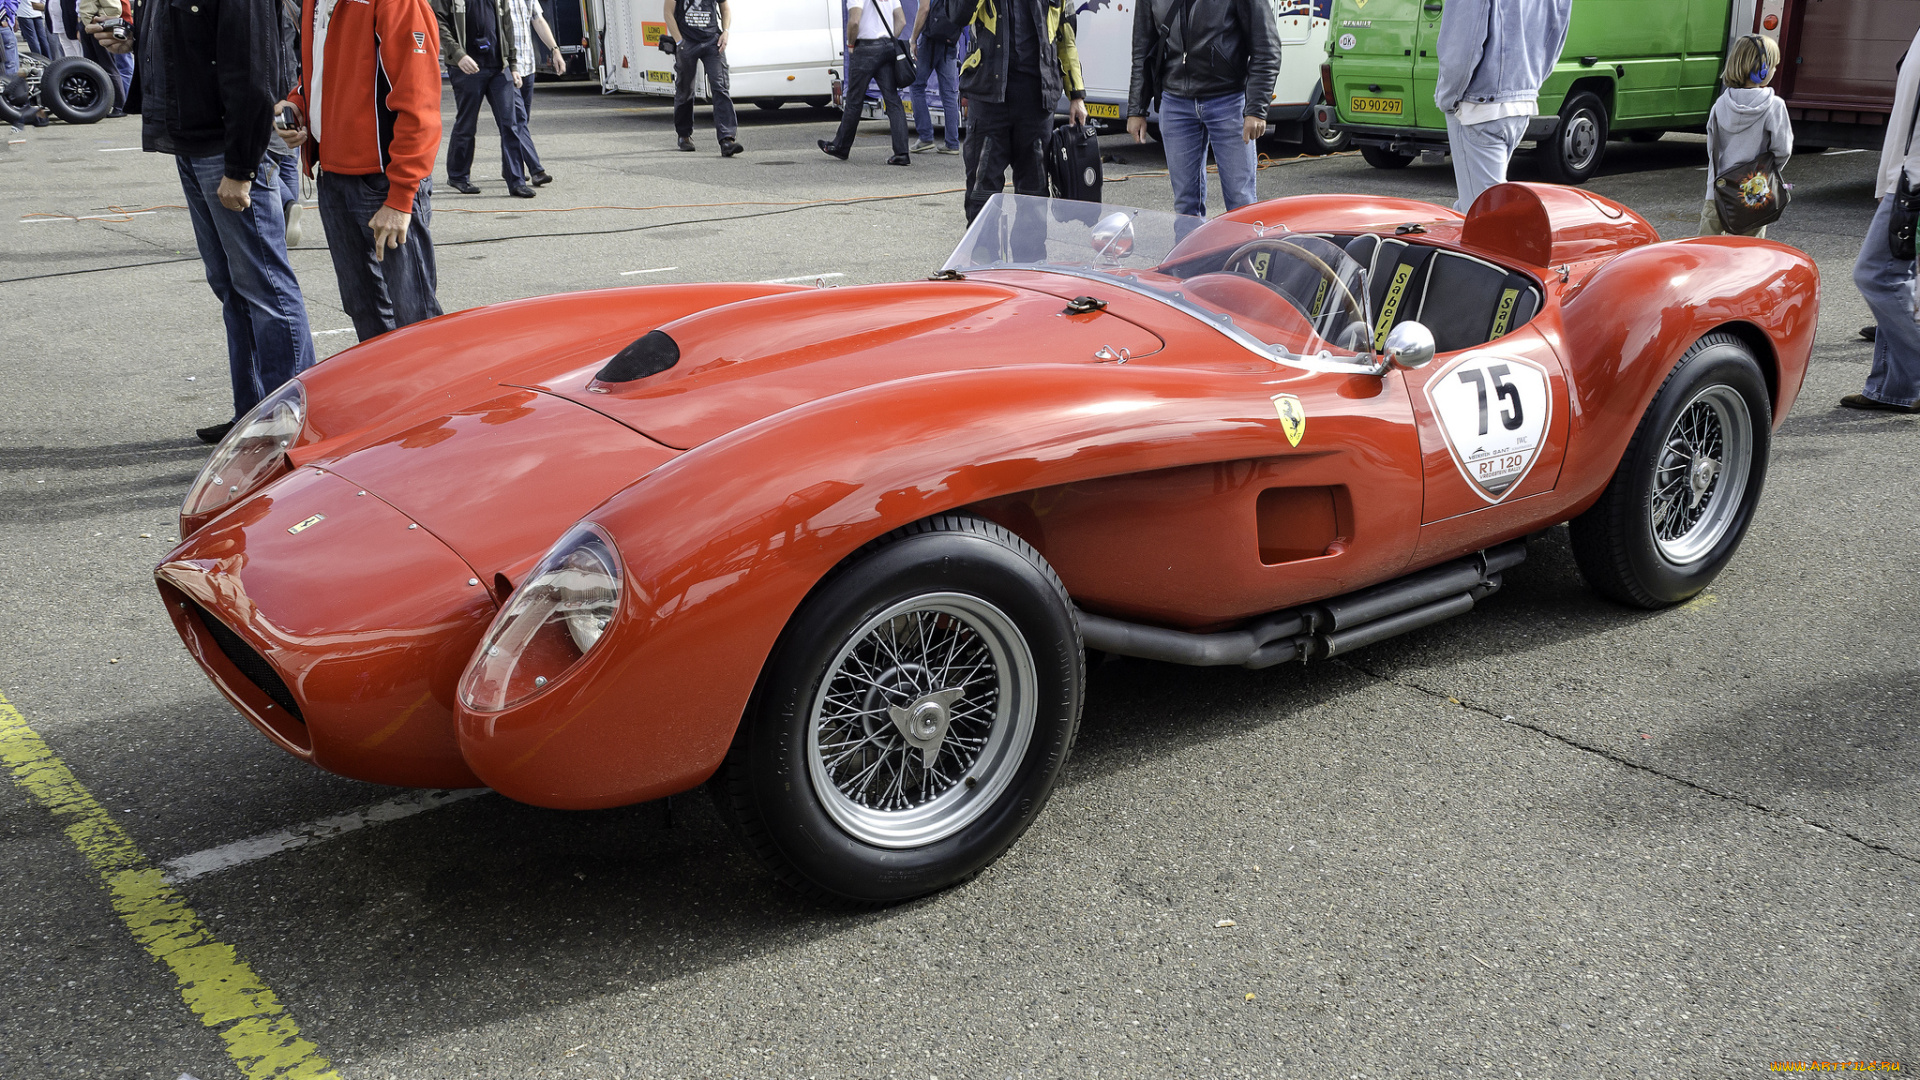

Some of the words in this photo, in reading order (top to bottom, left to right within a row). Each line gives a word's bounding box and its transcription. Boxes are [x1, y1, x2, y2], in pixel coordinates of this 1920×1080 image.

[647, 26, 660, 34] LONG
[1343, 20, 1372, 28] RENAULT
[1353, 99, 1366, 110] SD
[1375, 272, 1408, 343] Sabelt
[1457, 363, 1524, 436] 75
[1480, 460, 1495, 475] RT
[1500, 454, 1523, 470] 120
